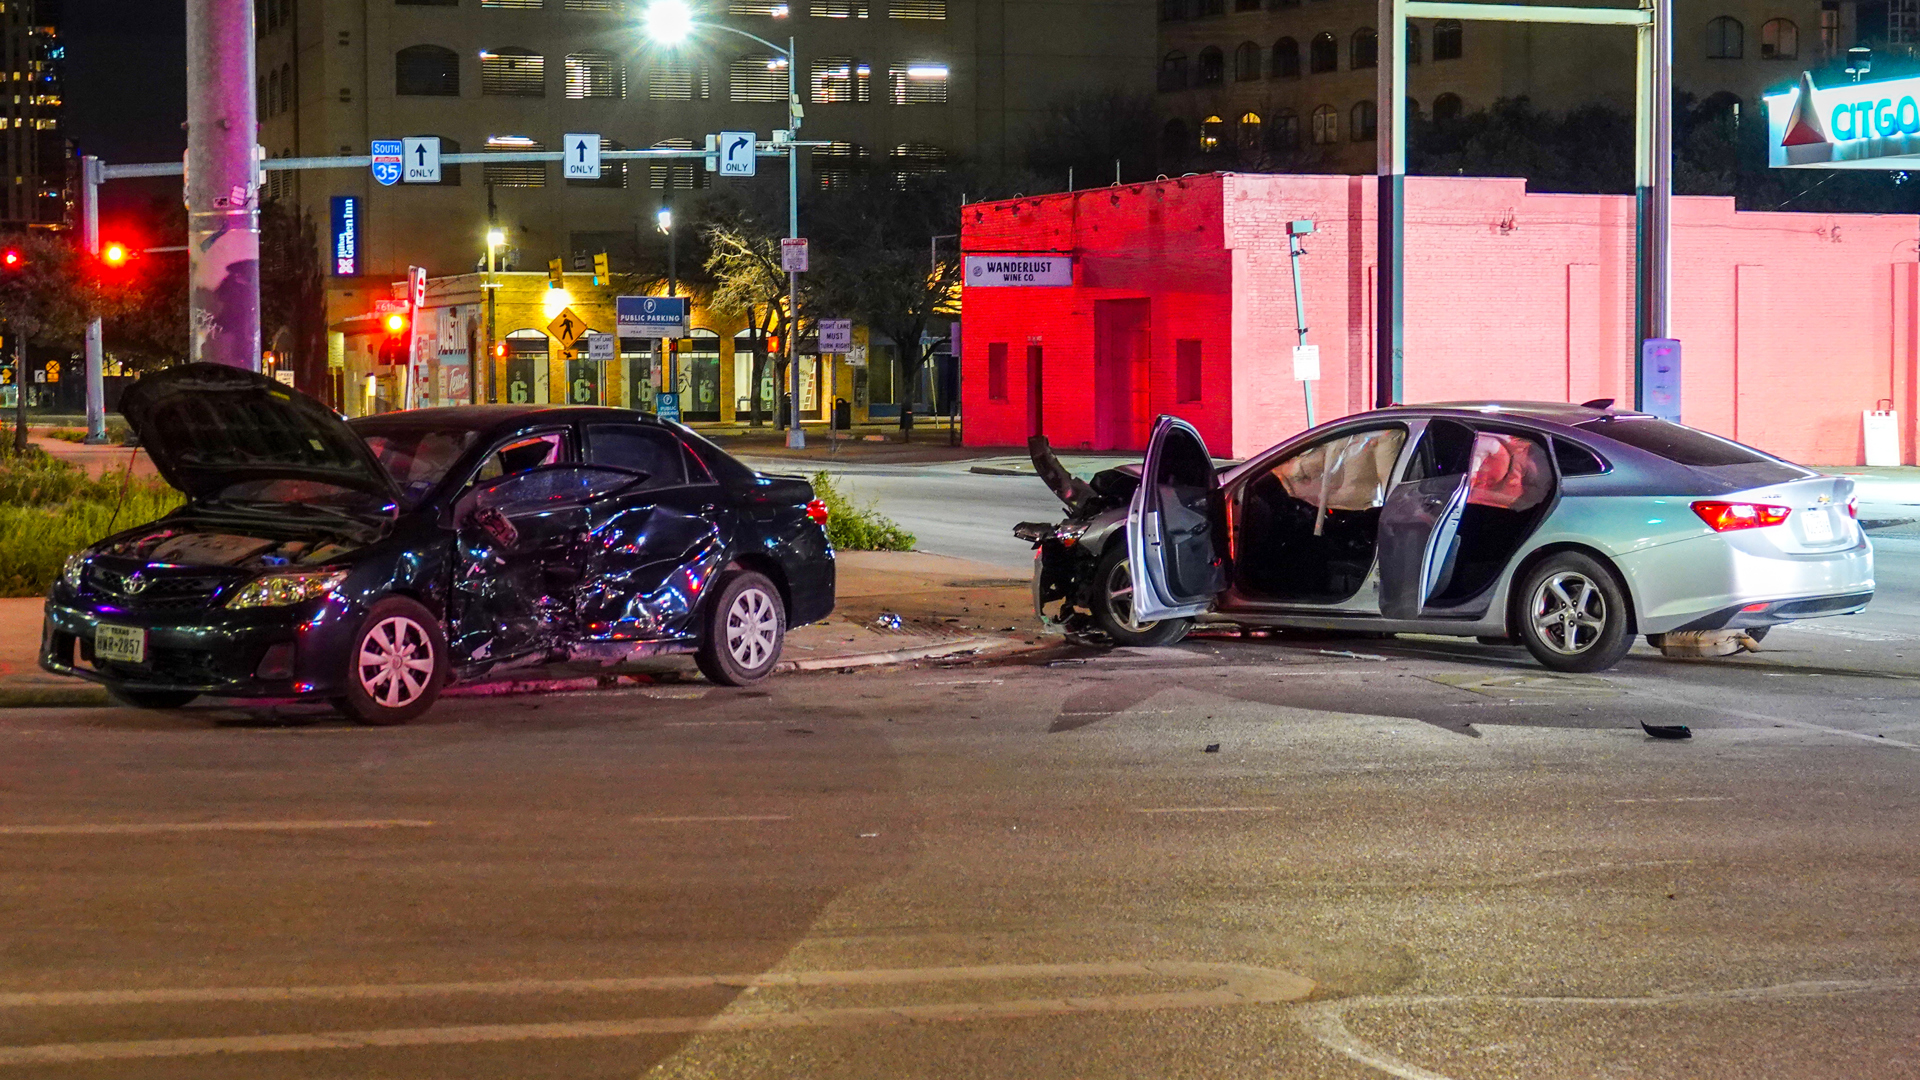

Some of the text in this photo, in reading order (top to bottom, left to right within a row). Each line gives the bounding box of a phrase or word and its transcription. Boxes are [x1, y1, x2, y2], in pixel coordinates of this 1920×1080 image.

[1831, 95, 1920, 141] CITGO
[374, 143, 400, 154] SOUTH
[377, 164, 398, 180] 35
[570, 165, 594, 174] ONLY
[726, 163, 749, 172] ONLY
[409, 169, 434, 178] ONLY
[343, 198, 354, 258] Garden Inn
[987, 262, 1052, 273] WANDERLUST
[1003, 273, 1036, 282] WINE CO.
[620, 314, 680, 322] PUBLIC PARKING
[826, 332, 843, 340] MUST
[511, 380, 528, 404] 6
[573, 378, 591, 403] 6
